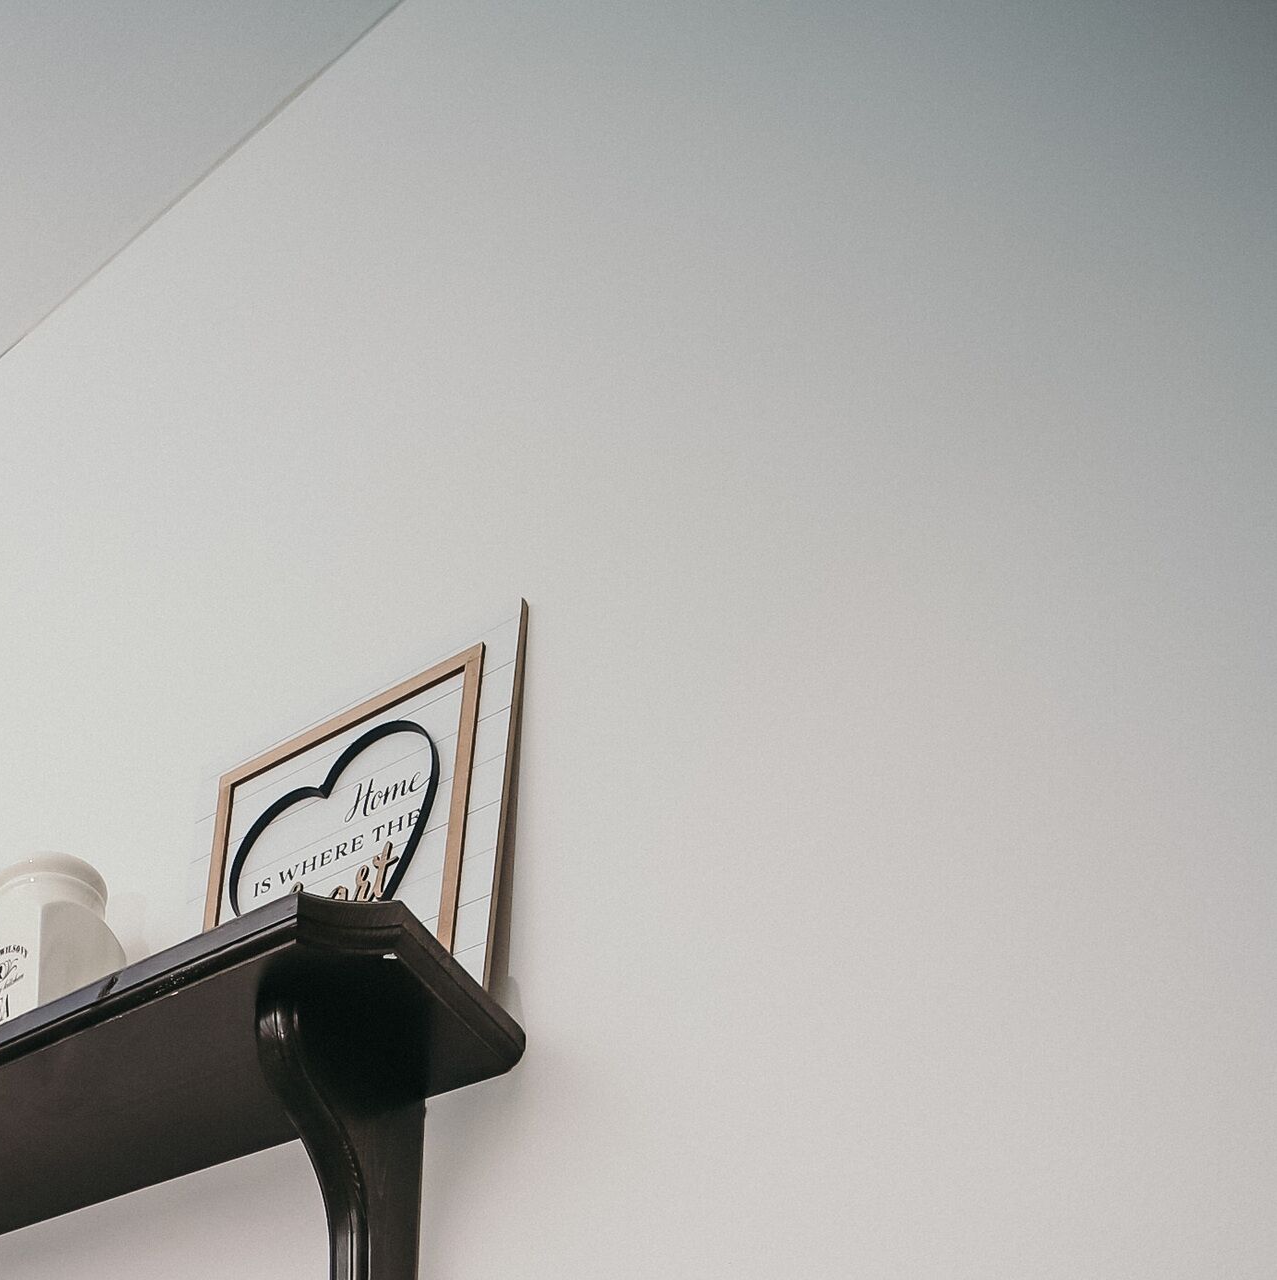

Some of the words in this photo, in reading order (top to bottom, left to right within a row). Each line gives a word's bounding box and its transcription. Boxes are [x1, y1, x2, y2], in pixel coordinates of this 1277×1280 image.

[344, 770, 429, 823] Home
[253, 877, 271, 898] IS
[278, 834, 364, 884] WHERE
[372, 808, 423, 843] THE
